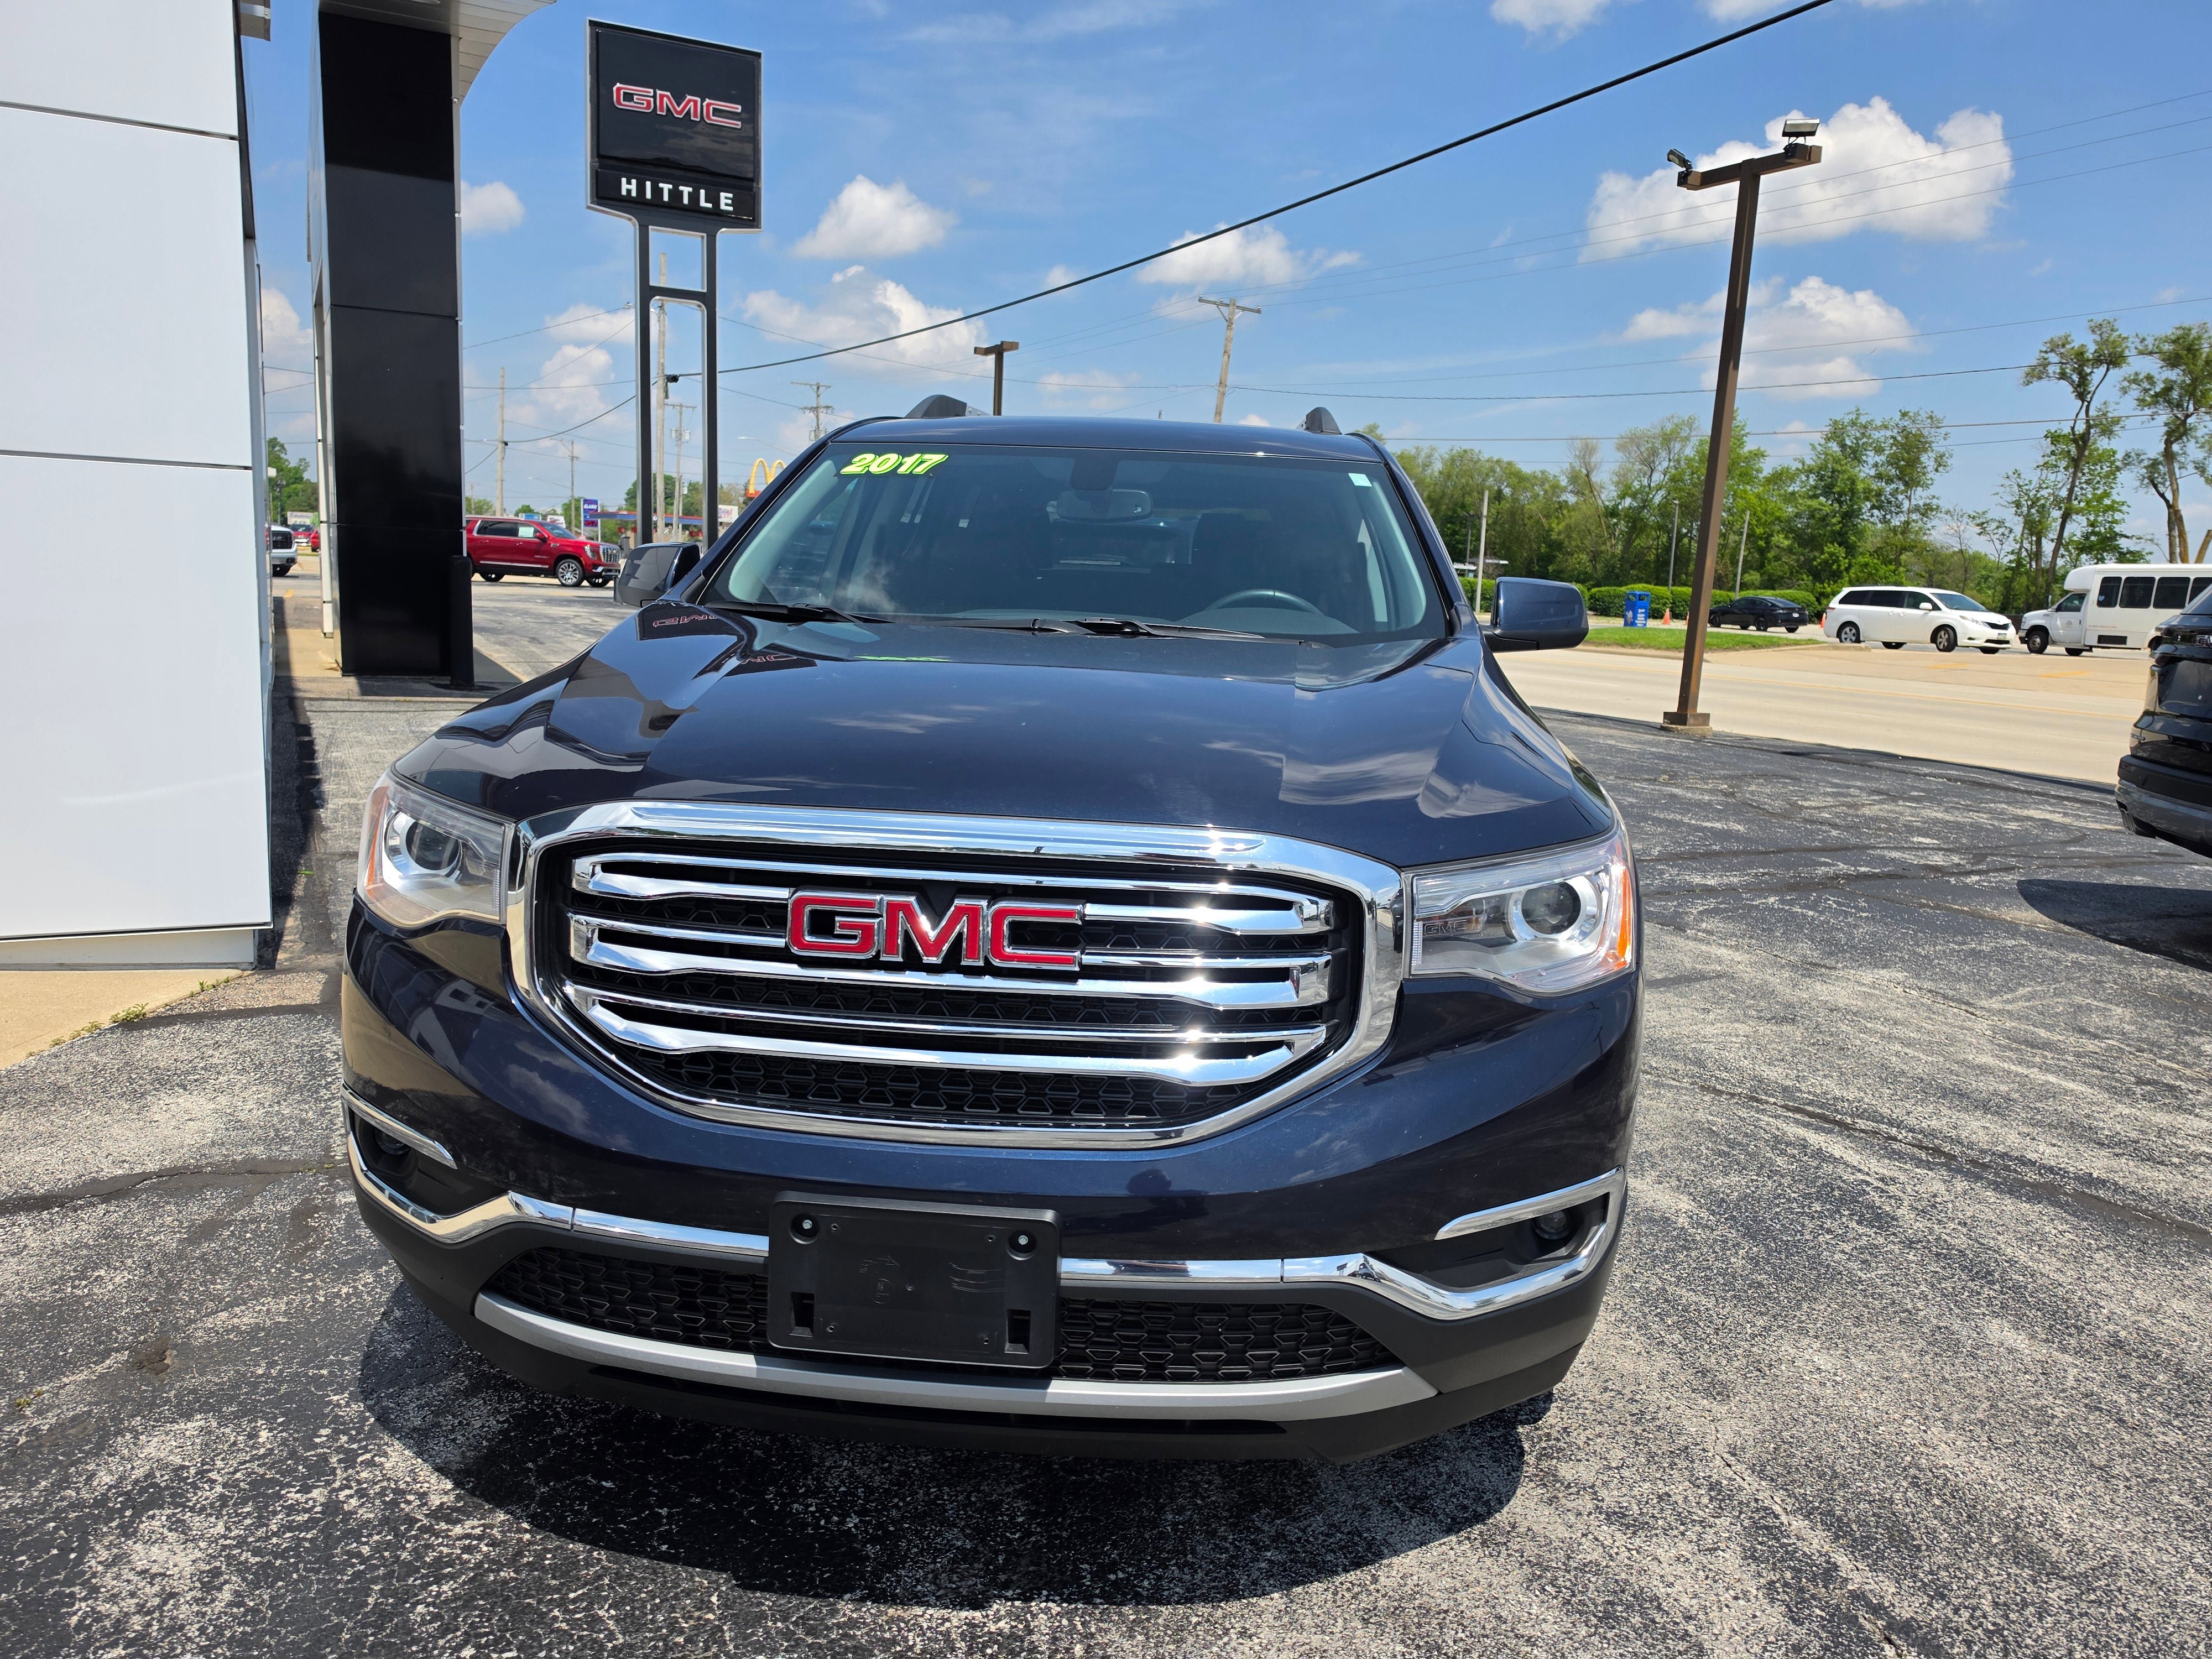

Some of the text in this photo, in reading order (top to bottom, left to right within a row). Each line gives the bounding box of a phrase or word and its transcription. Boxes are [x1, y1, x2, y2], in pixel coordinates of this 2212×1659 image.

[613, 82, 742, 129] GMC
[620, 178, 734, 211] HITTLE
[840, 453, 949, 474] 2017
[788, 888, 1084, 971] GMC
[1424, 920, 1467, 936] GMC
